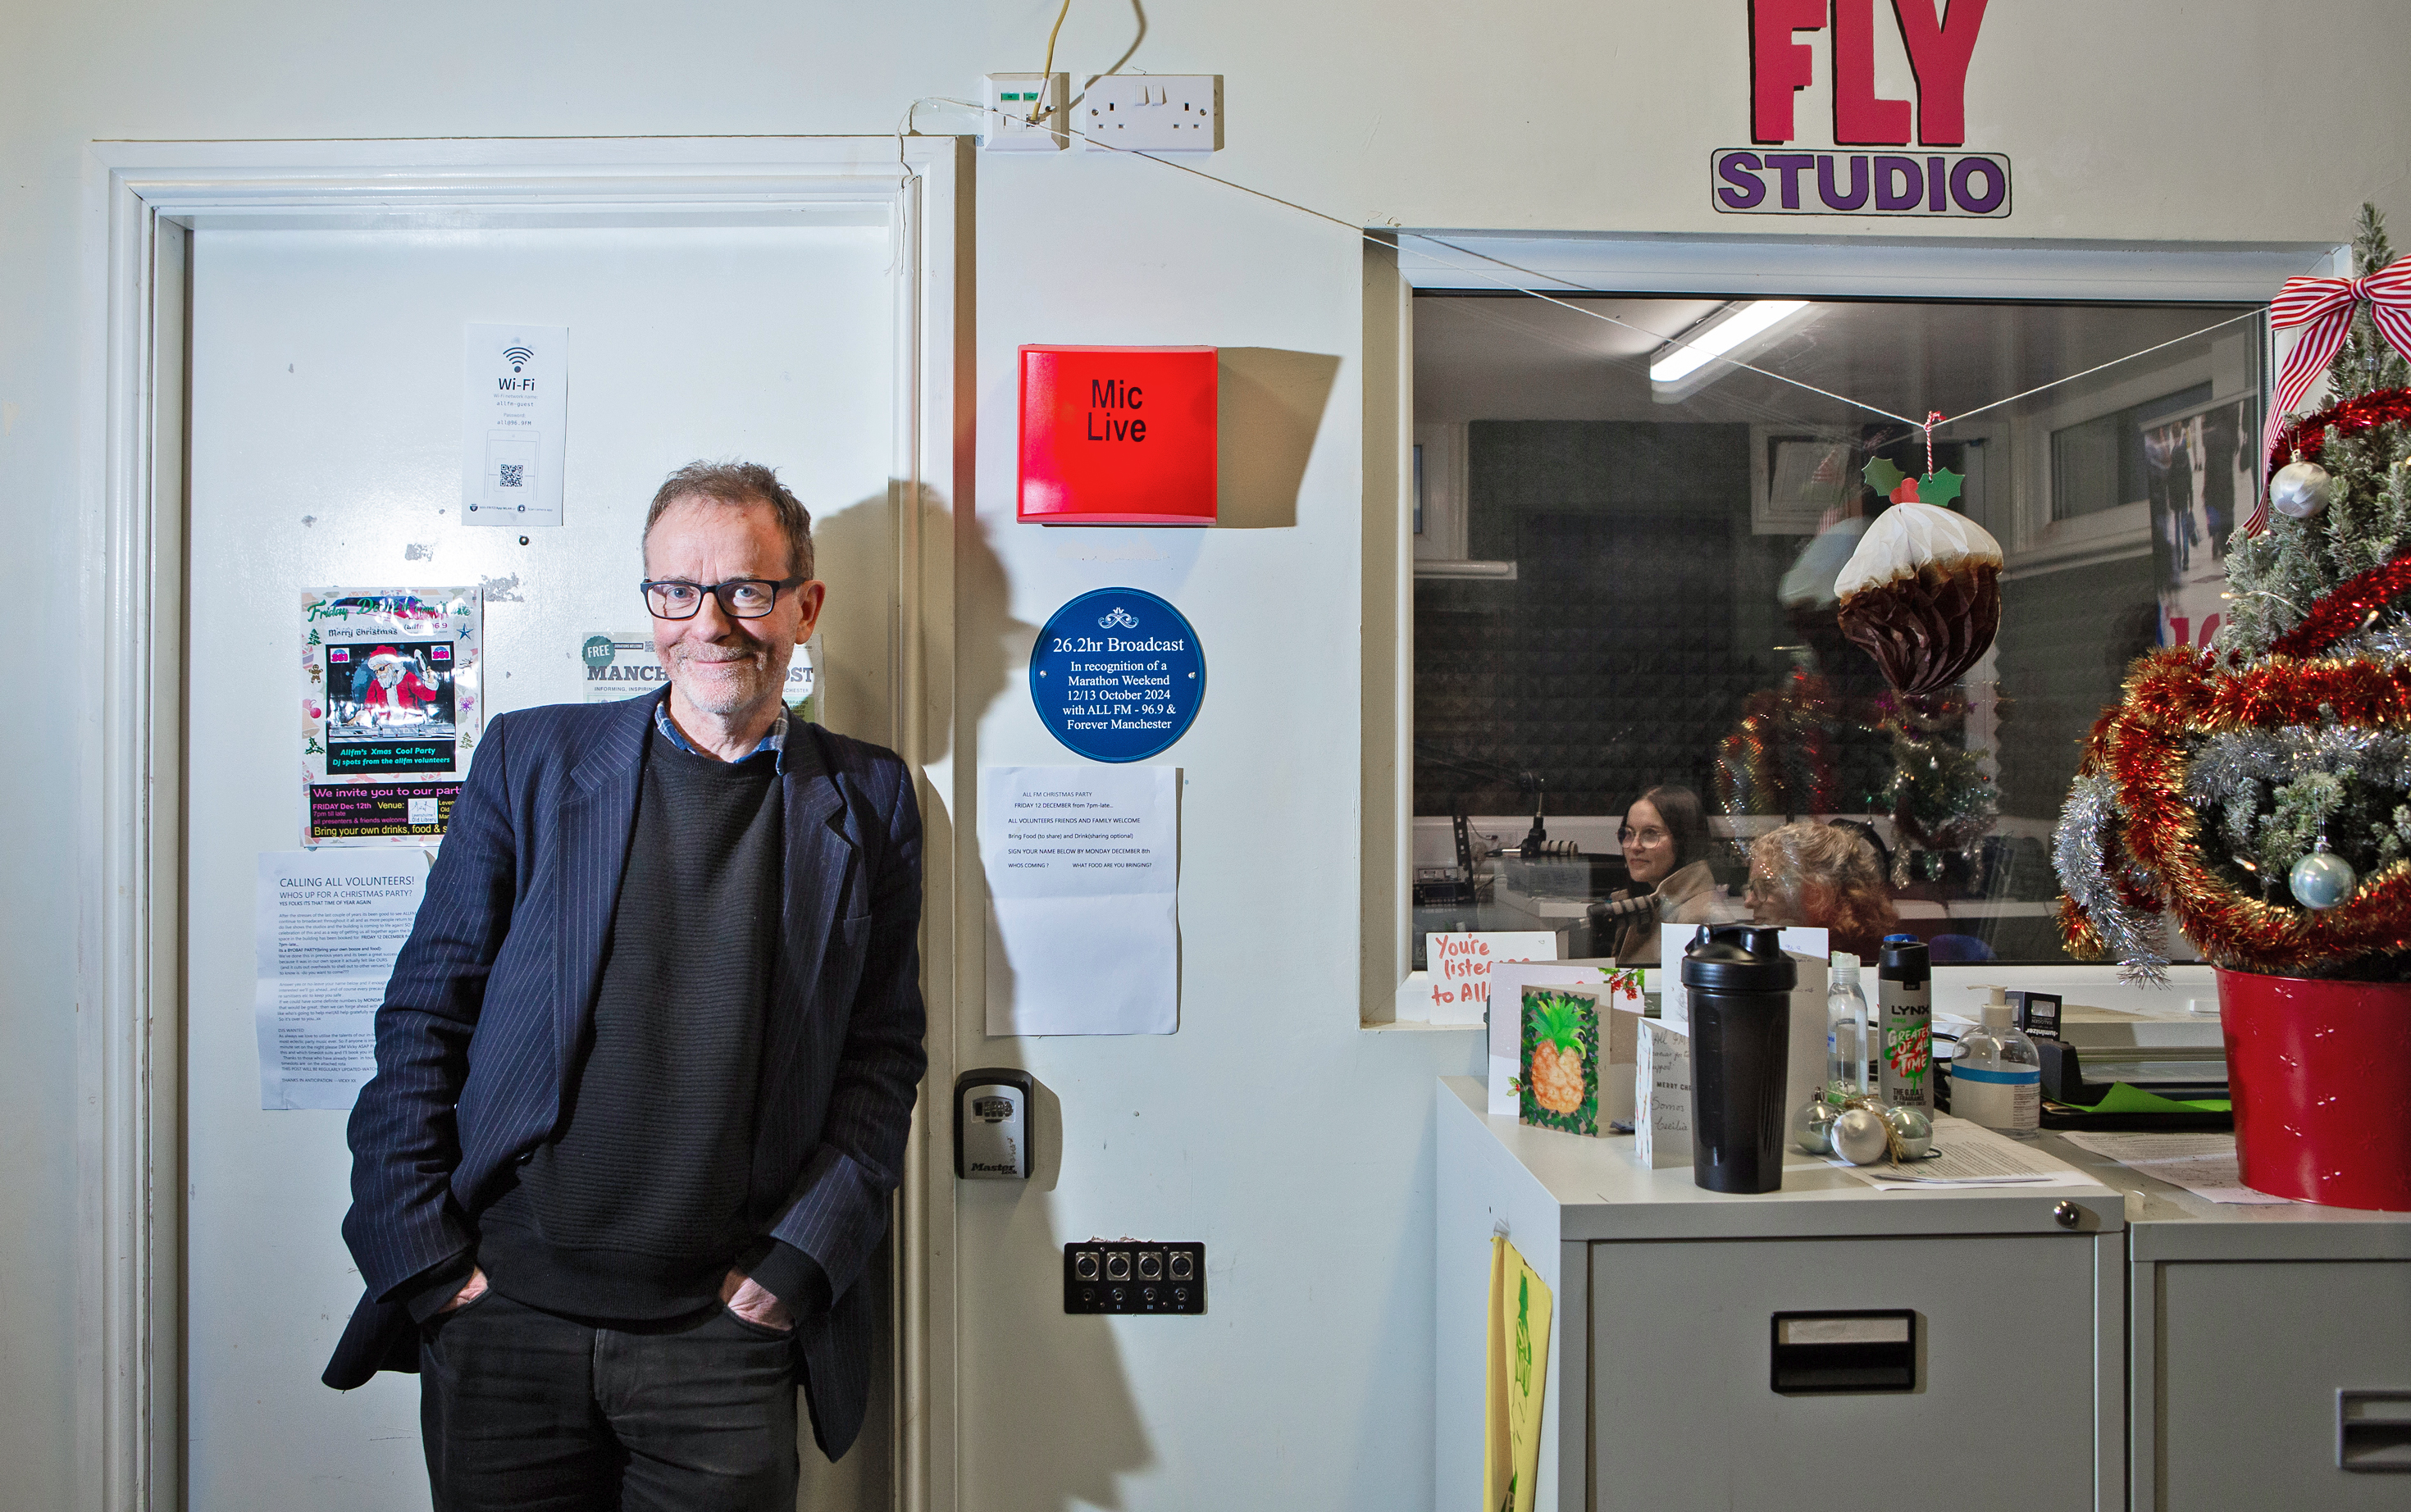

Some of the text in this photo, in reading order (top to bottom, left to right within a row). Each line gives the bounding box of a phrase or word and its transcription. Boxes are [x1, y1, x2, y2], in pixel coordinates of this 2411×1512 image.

[1717, 152, 2006, 214] STUDIO
[499, 377, 535, 391] Wi-Fi
[1092, 380, 1142, 409] Mic
[1087, 412, 1146, 442] Live
[307, 599, 349, 622] Friday
[328, 629, 353, 638] Merry
[356, 627, 398, 636] Christmas
[1053, 636, 1184, 653] 26.2hr Broadcast
[587, 644, 610, 658] FREE
[1071, 661, 1167, 673] In recognition of a
[1069, 675, 1169, 685] Marathon Weekend
[1068, 690, 1170, 700] 12/13 October 2024
[1063, 705, 1084, 715] with
[1087, 705, 1111, 715] ALL
[1114, 704, 1132, 714] FM
[1142, 704, 1164, 714] 96.9
[1166, 704, 1176, 714] &
[1067, 719, 1172, 729] Forever Manchester
[312, 789, 332, 797] We
[336, 788, 367, 797] invite
[371, 790, 394, 799] you
[436, 787, 461, 797] part
[314, 827, 337, 837] Bring
[339, 827, 358, 837] your
[381, 826, 410, 835] drinks,
[412, 825, 431, 833] food
[434, 825, 440, 833] &
[280, 877, 414, 887] CALLING ALL VOLUNTEERS!
[1432, 984, 1454, 1006] to
[1891, 1004, 1930, 1015] LYNX
[970, 1163, 1016, 1172] Master
